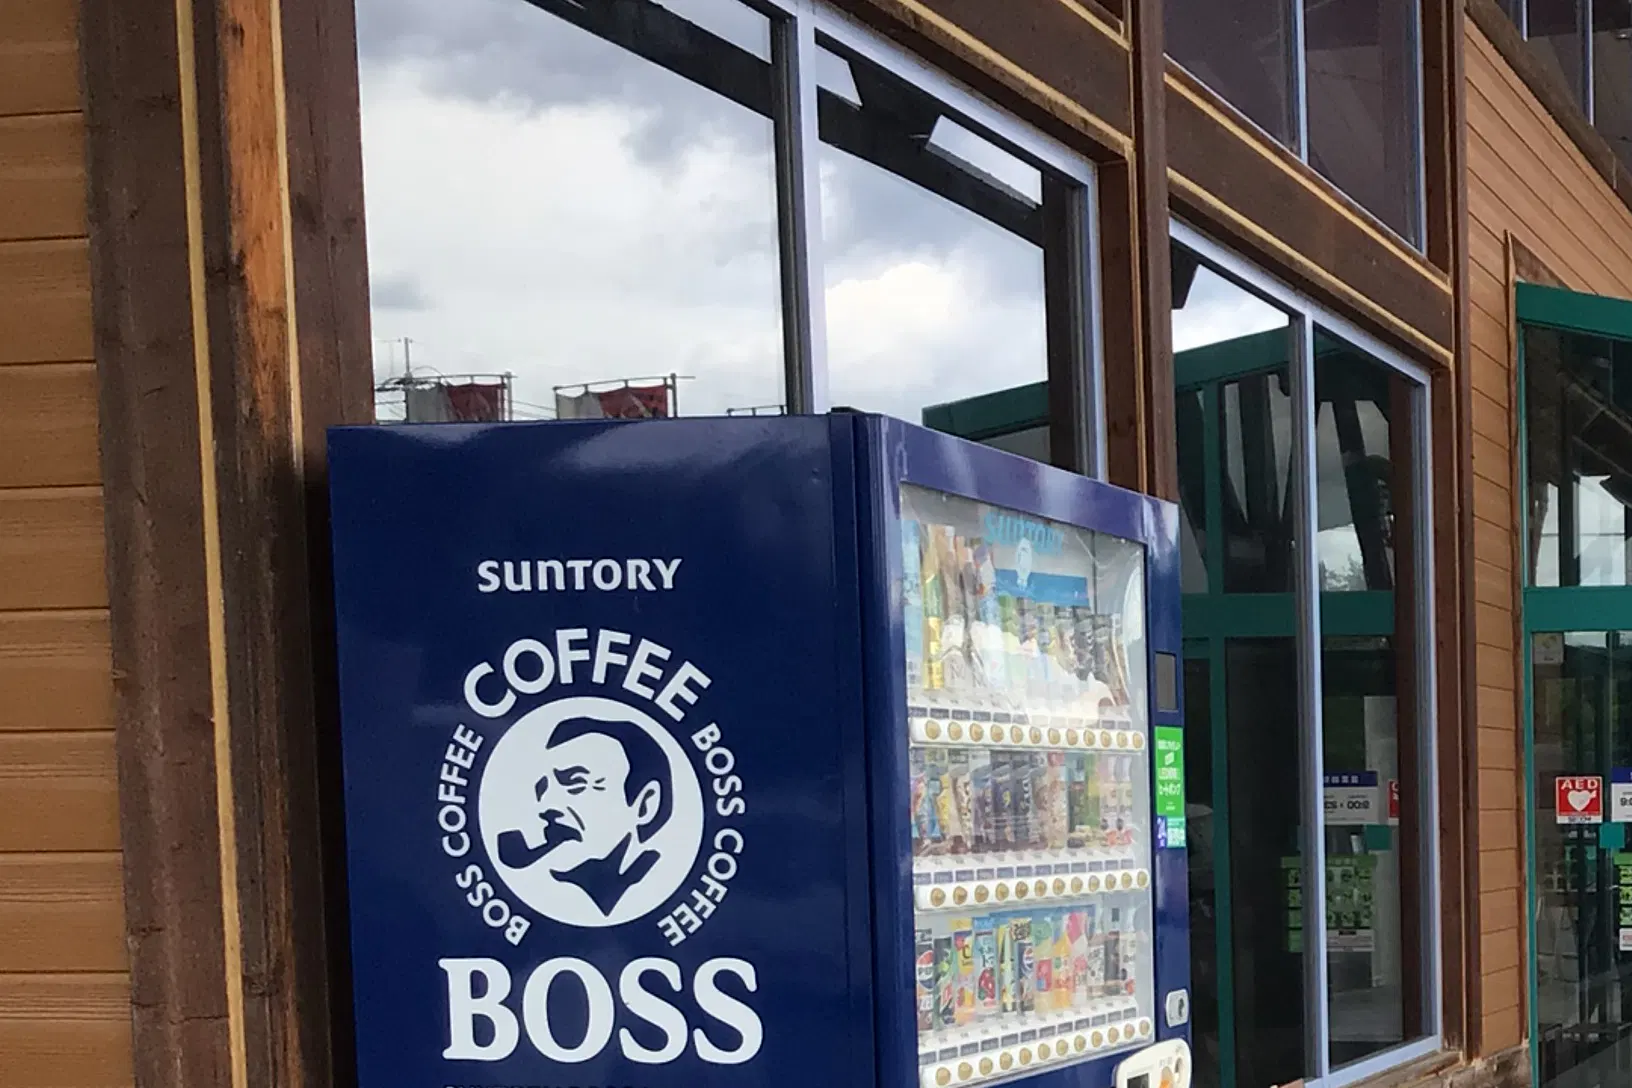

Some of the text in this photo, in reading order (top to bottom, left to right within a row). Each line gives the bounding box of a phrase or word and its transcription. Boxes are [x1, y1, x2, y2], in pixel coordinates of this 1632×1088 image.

[463, 627, 712, 722] COFFEE
[437, 724, 531, 946] BOSS COFFEE
[657, 722, 746, 947] BOSS COFFEE
[1560, 779, 1598, 790] AED
[438, 956, 763, 1065] BOSS
